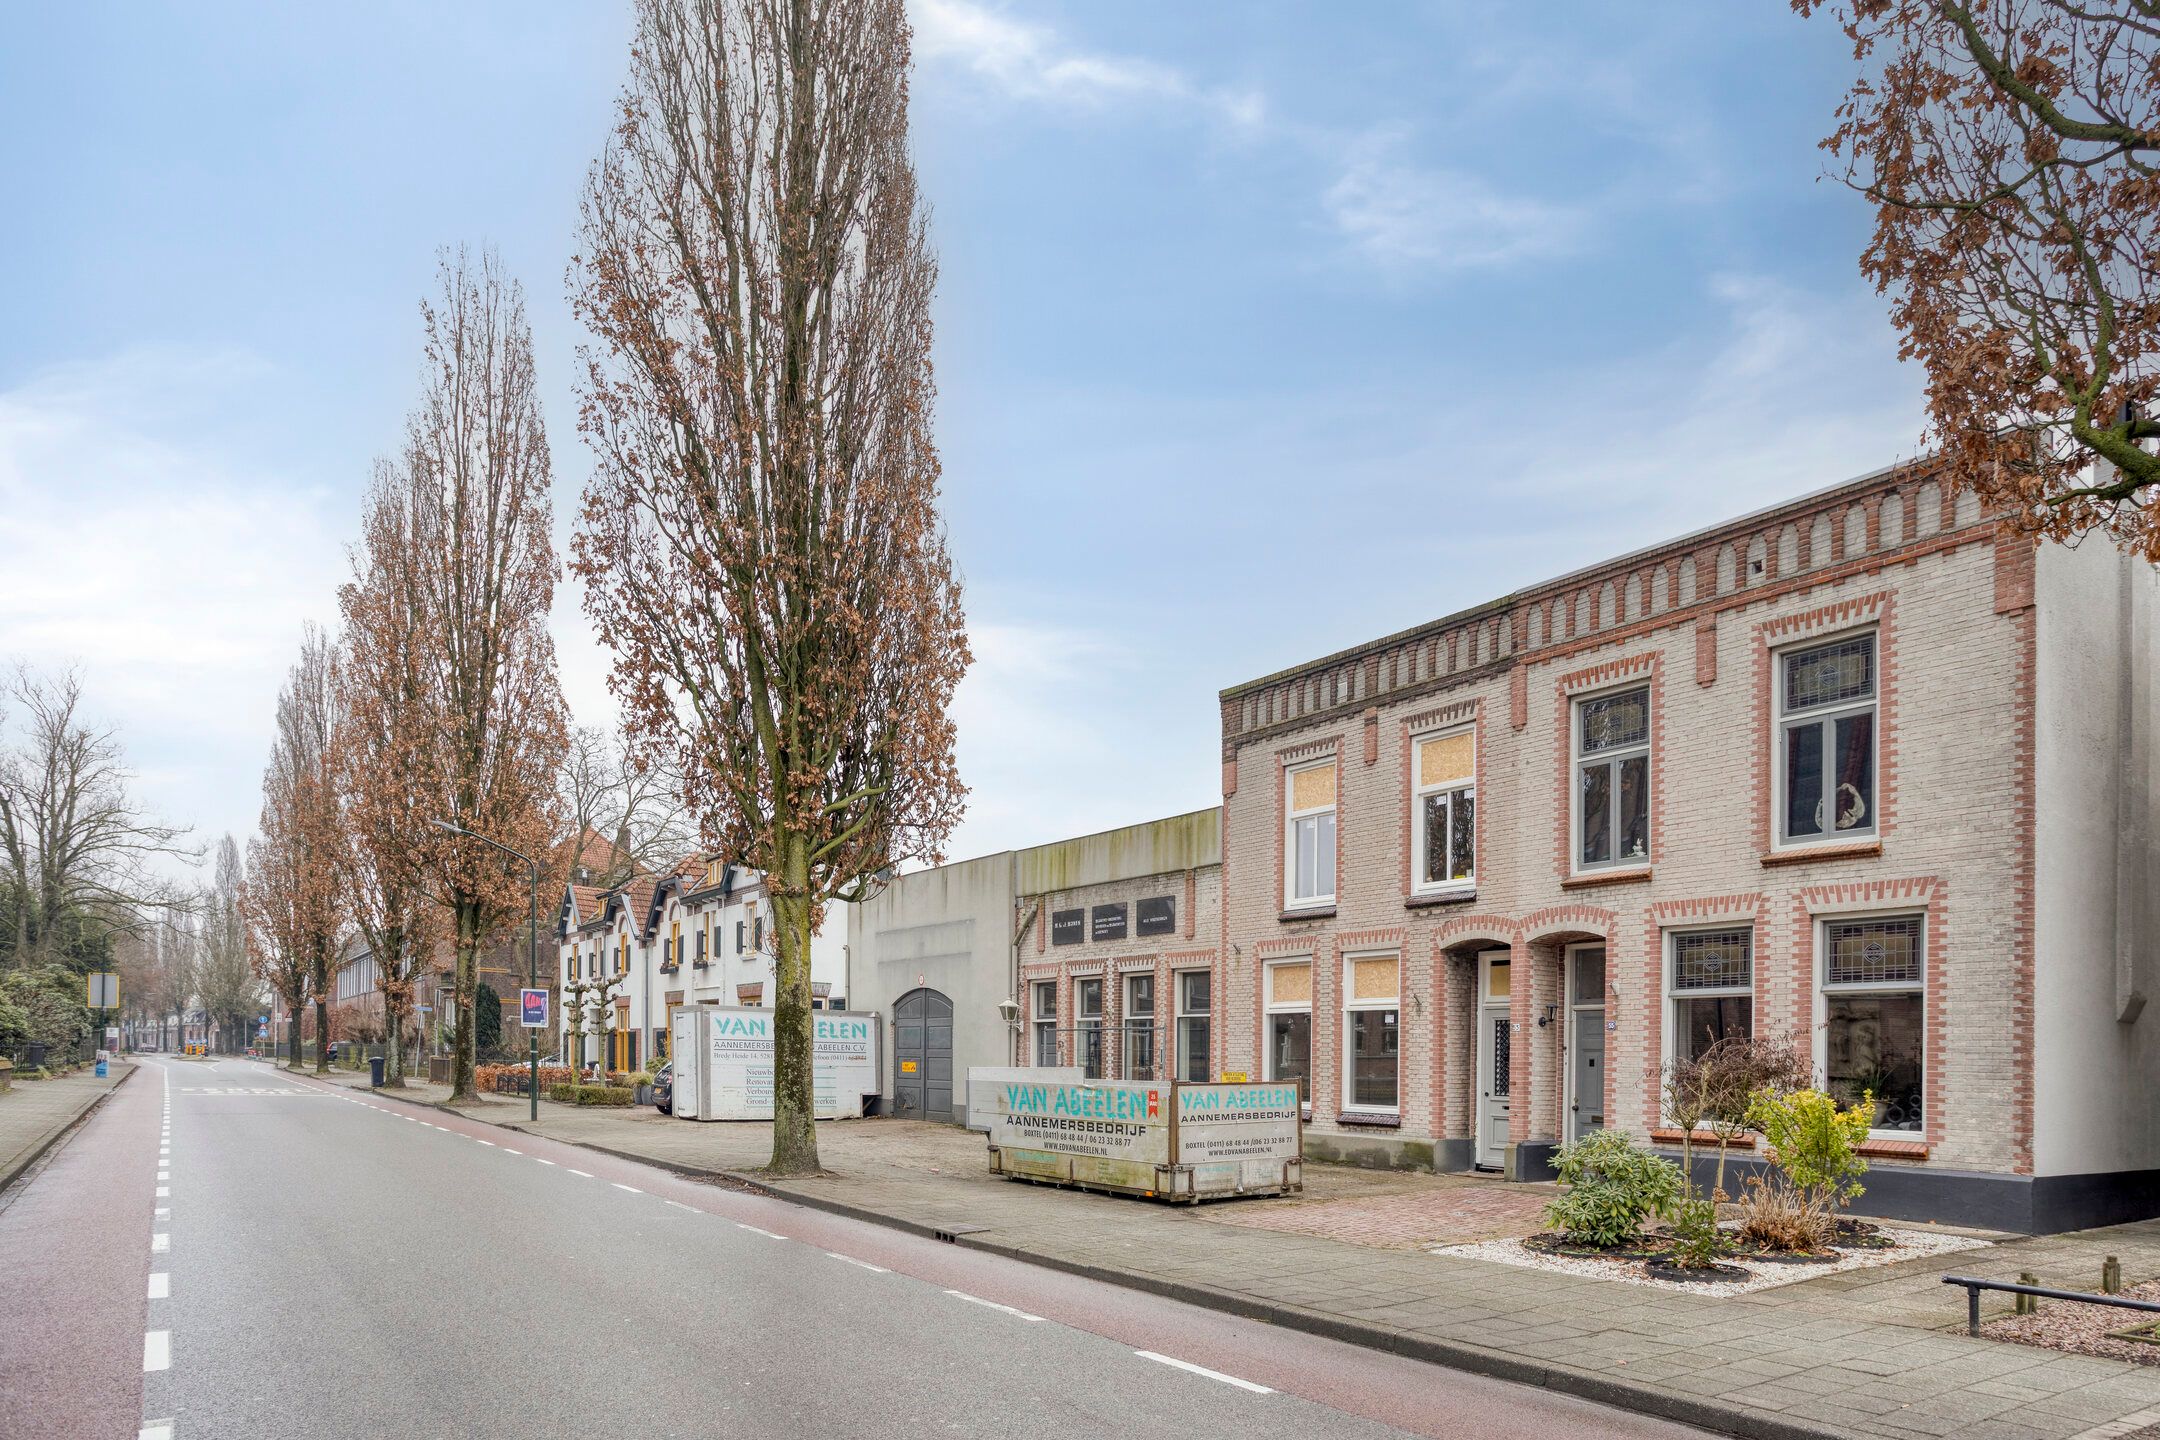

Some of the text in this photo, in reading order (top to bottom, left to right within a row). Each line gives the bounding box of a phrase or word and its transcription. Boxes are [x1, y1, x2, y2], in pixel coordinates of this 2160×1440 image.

[714, 1017, 867, 1040] VAN ELEN
[714, 1041, 775, 1049] AANNEMERSBE
[746, 1068, 775, 1076] Nieuwbo
[1007, 1084, 1147, 1120] VAN ABEELEN
[1181, 1087, 1296, 1110] VAN ABEELEN
[1181, 1111, 1296, 1123] AANNEMERSBEDRIJF
[1006, 1115, 1146, 1136] AANNEMERSBEDRIJF
[1024, 1129, 1042, 1138] BOXTEL
[1043, 1129, 1059, 1140] (0411)
[1068, 1133, 1075, 1141] 48
[1090, 1135, 1096, 1143] 06
[1098, 1136, 1105, 1144] 23
[1106, 1137, 1113, 1145] 32
[1115, 1138, 1122, 1146] 88
[1124, 1138, 1131, 1147] 77
[1185, 1141, 1206, 1149] BOXTEL
[1207, 1139, 1224, 1148] (0411)
[1225, 1139, 1233, 1147] 68
[1043, 1142, 1108, 1156] WWW.EDVANABEELEN.NL
[1208, 1147, 1272, 1156] WWW.EDVANABEELEN.NL
